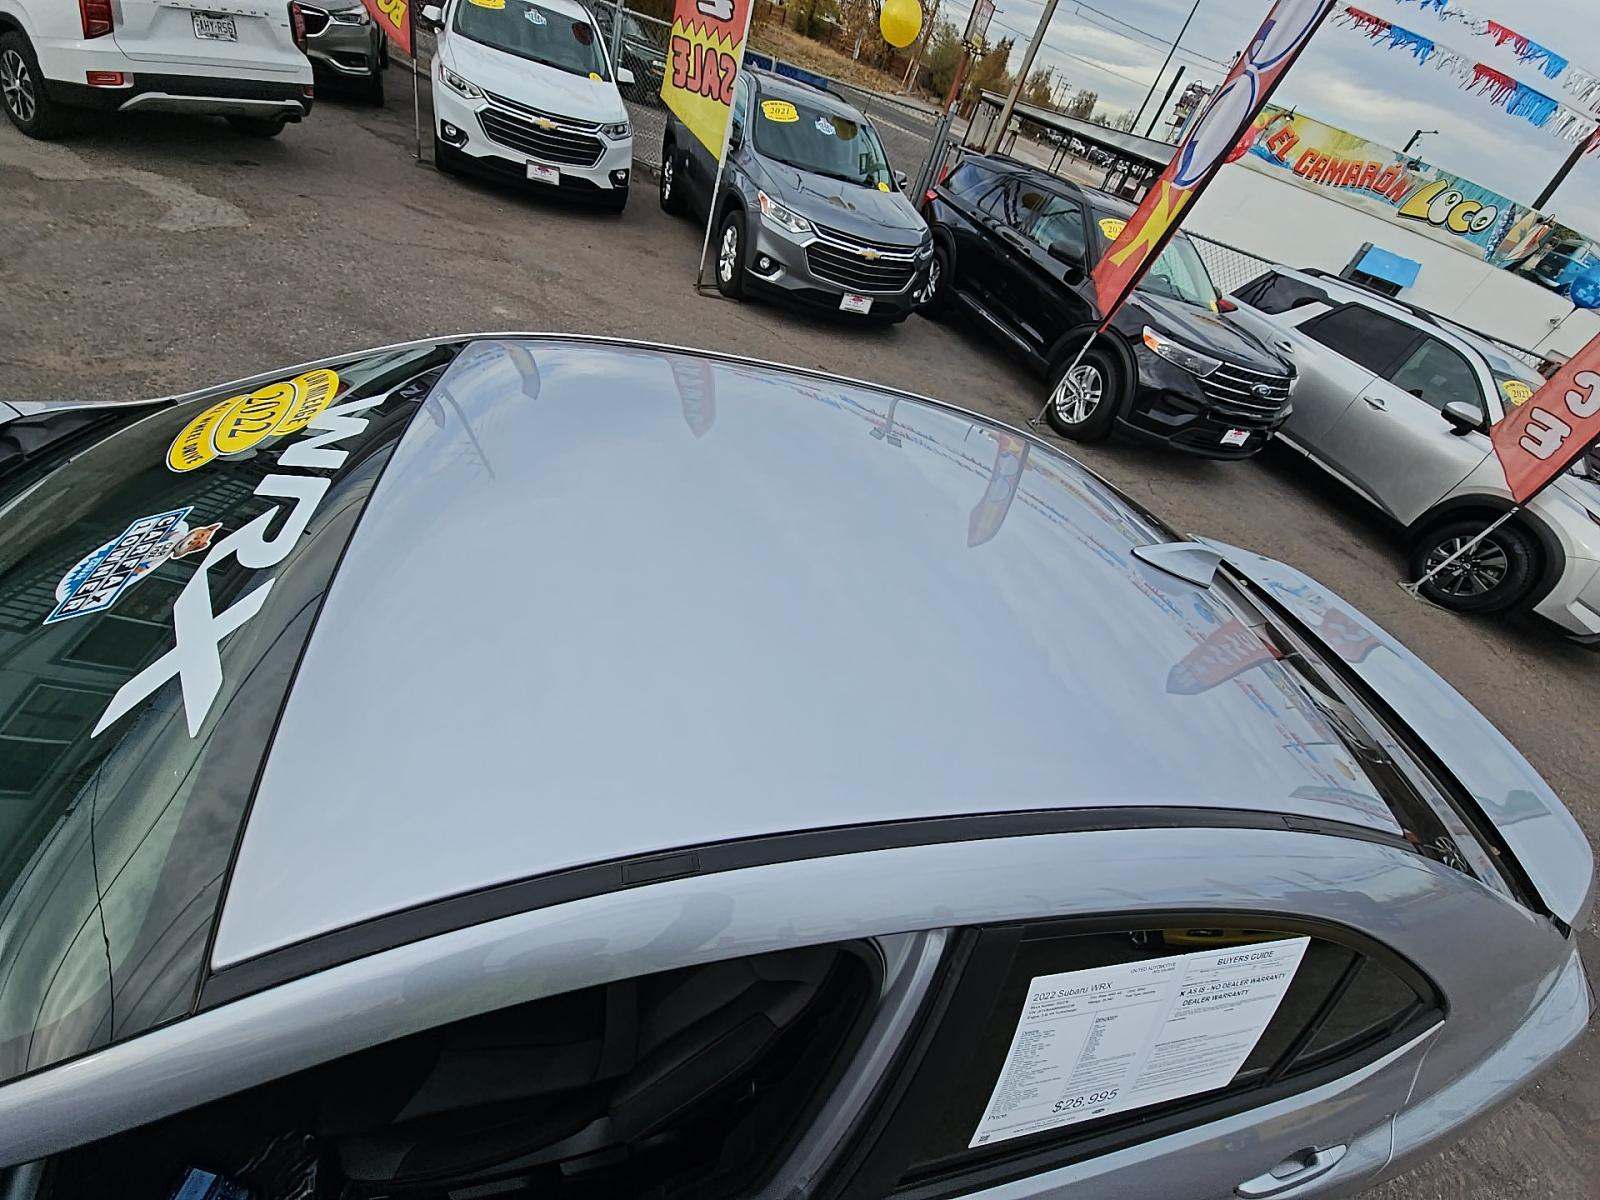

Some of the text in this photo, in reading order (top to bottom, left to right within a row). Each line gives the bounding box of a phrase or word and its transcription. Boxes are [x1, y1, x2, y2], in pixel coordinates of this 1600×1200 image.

[1266, 125, 1300, 164] EL
[1292, 147, 1416, 205] CAMARÓN
[228, 391, 285, 438] 2022
[89, 515, 177, 607] CARFAX
[91, 391, 397, 740] WRX
[1217, 951, 1275, 966] BUYERS GUIDE
[1033, 992, 1056, 1002] 2022
[1058, 987, 1088, 998] Subaru
[1091, 982, 1113, 992] WRX
[1222, 978, 1249, 989] DEALER
[1250, 973, 1286, 985] WARRANTY
[1182, 989, 1249, 1007] DEALER WARRANTY
